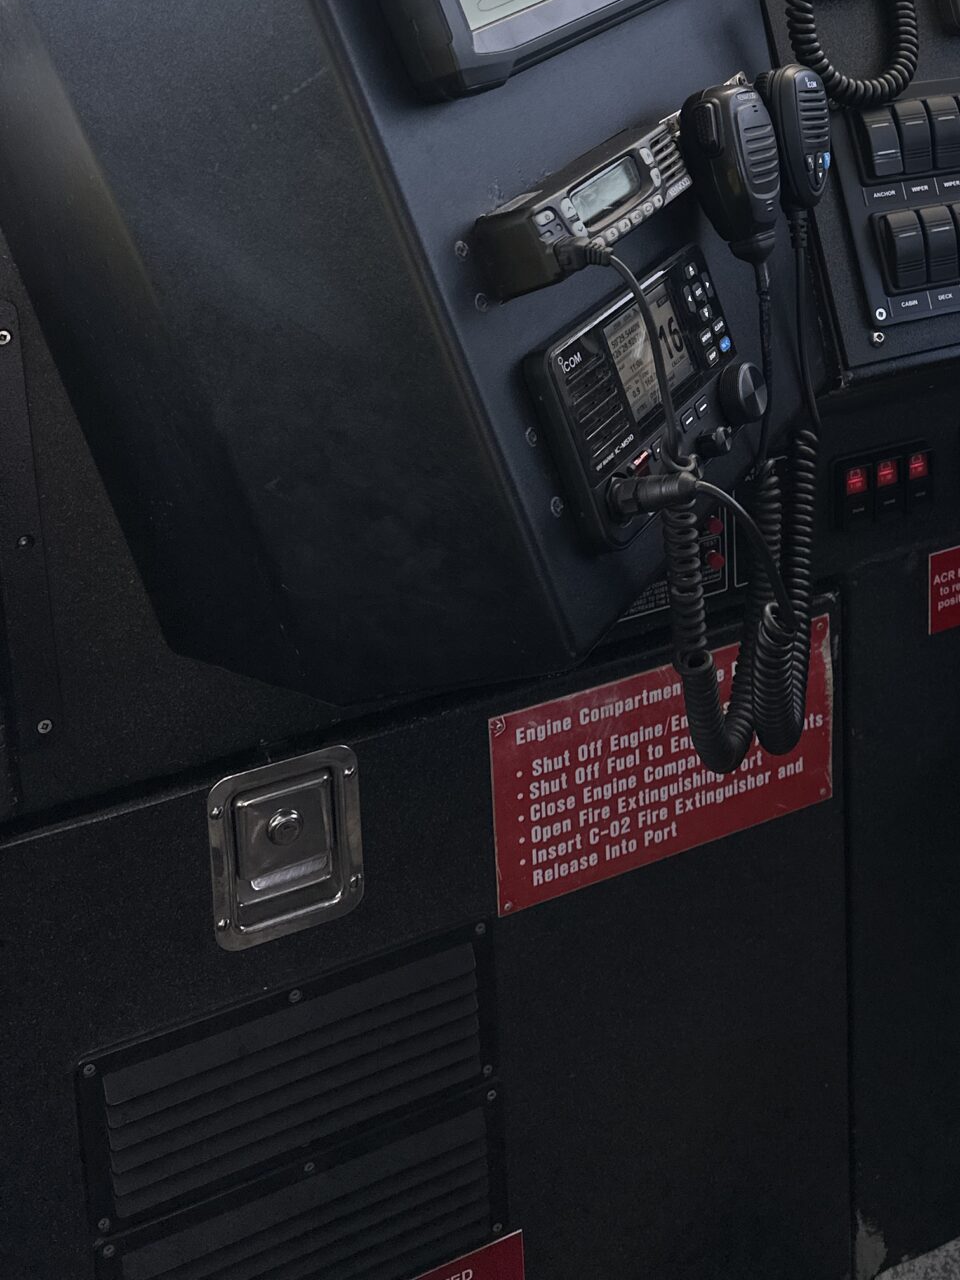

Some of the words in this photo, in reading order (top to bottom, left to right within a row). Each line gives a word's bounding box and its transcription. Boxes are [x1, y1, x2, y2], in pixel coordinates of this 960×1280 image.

[873, 190, 896, 198] ANCHOR
[911, 185, 929, 193] WIPER
[943, 180, 960, 188] WIPER
[901, 300, 918, 308] CABIN
[659, 316, 684, 359] 16
[933, 570, 956, 586] ACR
[940, 586, 950, 596] to
[515, 716, 572, 746] Engine
[579, 681, 683, 726] Compartmen
[529, 772, 568, 800] Shut
[574, 762, 600, 785] Off
[607, 749, 641, 775] Fuel
[647, 743, 664, 761] to
[532, 750, 570, 777] Shut
[577, 739, 603, 762] Off
[530, 796, 576, 822] Close
[583, 775, 637, 804] Engine
[531, 818, 572, 844] Open
[578, 805, 611, 828] Fire
[617, 771, 724, 815] Extinguishing
[531, 833, 582, 866] Insert
[638, 807, 669, 829] Fire
[675, 770, 772, 816] Extinguisher
[777, 757, 804, 780] and
[532, 852, 599, 887] Release
[605, 839, 637, 861] Into
[644, 821, 678, 847] Port
